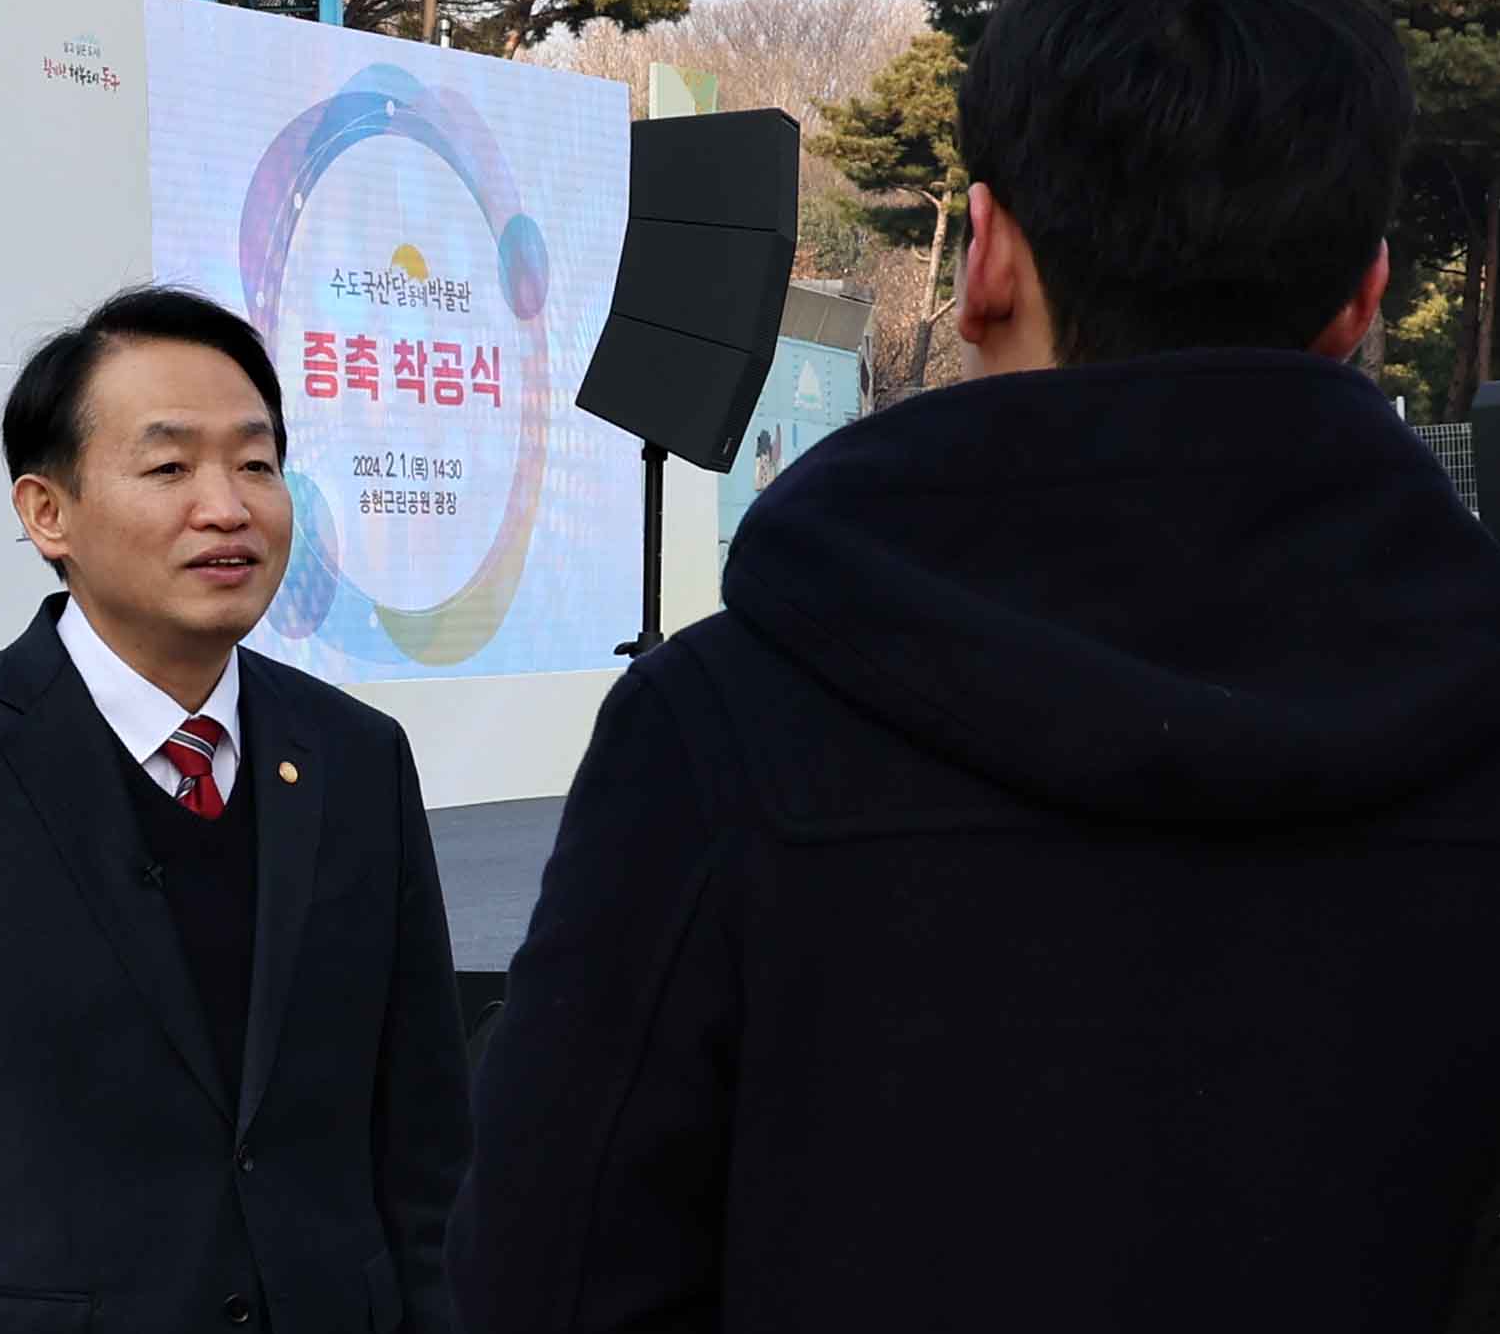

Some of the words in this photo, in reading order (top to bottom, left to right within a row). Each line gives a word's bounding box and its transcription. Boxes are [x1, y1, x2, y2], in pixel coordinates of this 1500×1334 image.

[304, 332, 379, 401] 증축
[394, 339, 501, 407] 착공식
[433, 458, 462, 480] 14:30
[360, 489, 431, 514] 송현근린공원
[434, 491, 457, 516] 광장
